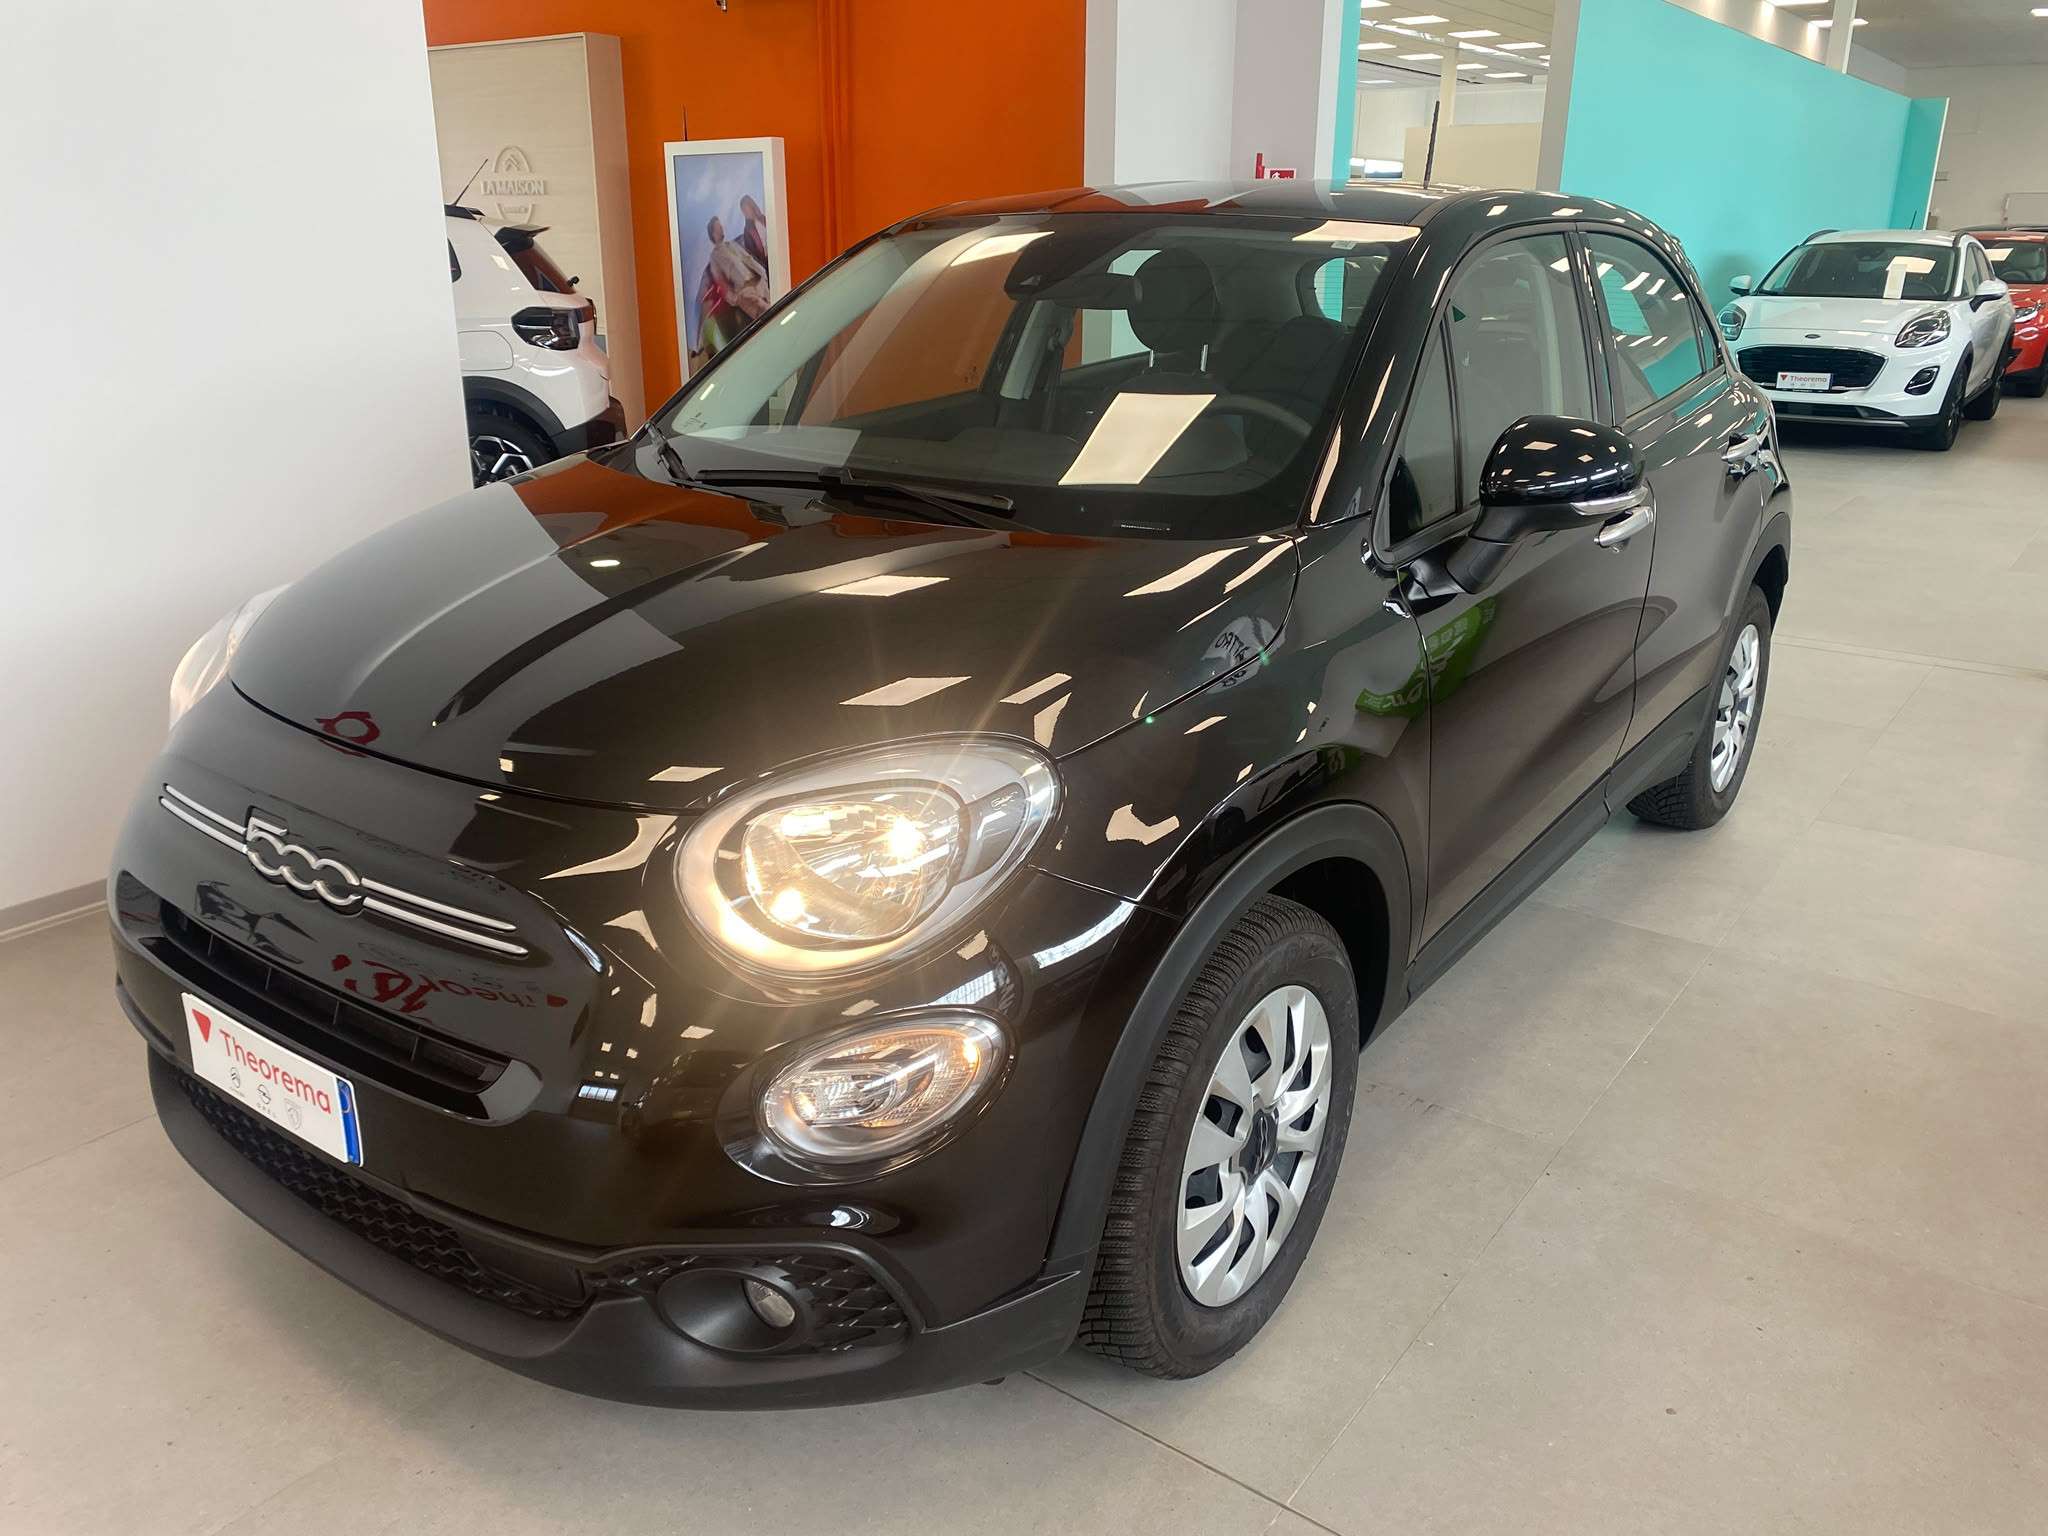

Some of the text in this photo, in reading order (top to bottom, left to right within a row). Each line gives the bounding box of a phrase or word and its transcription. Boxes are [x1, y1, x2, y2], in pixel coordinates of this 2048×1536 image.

[497, 180, 546, 195] MAISON
[246, 816, 361, 906] 500
[219, 1028, 332, 1115] Theorema
